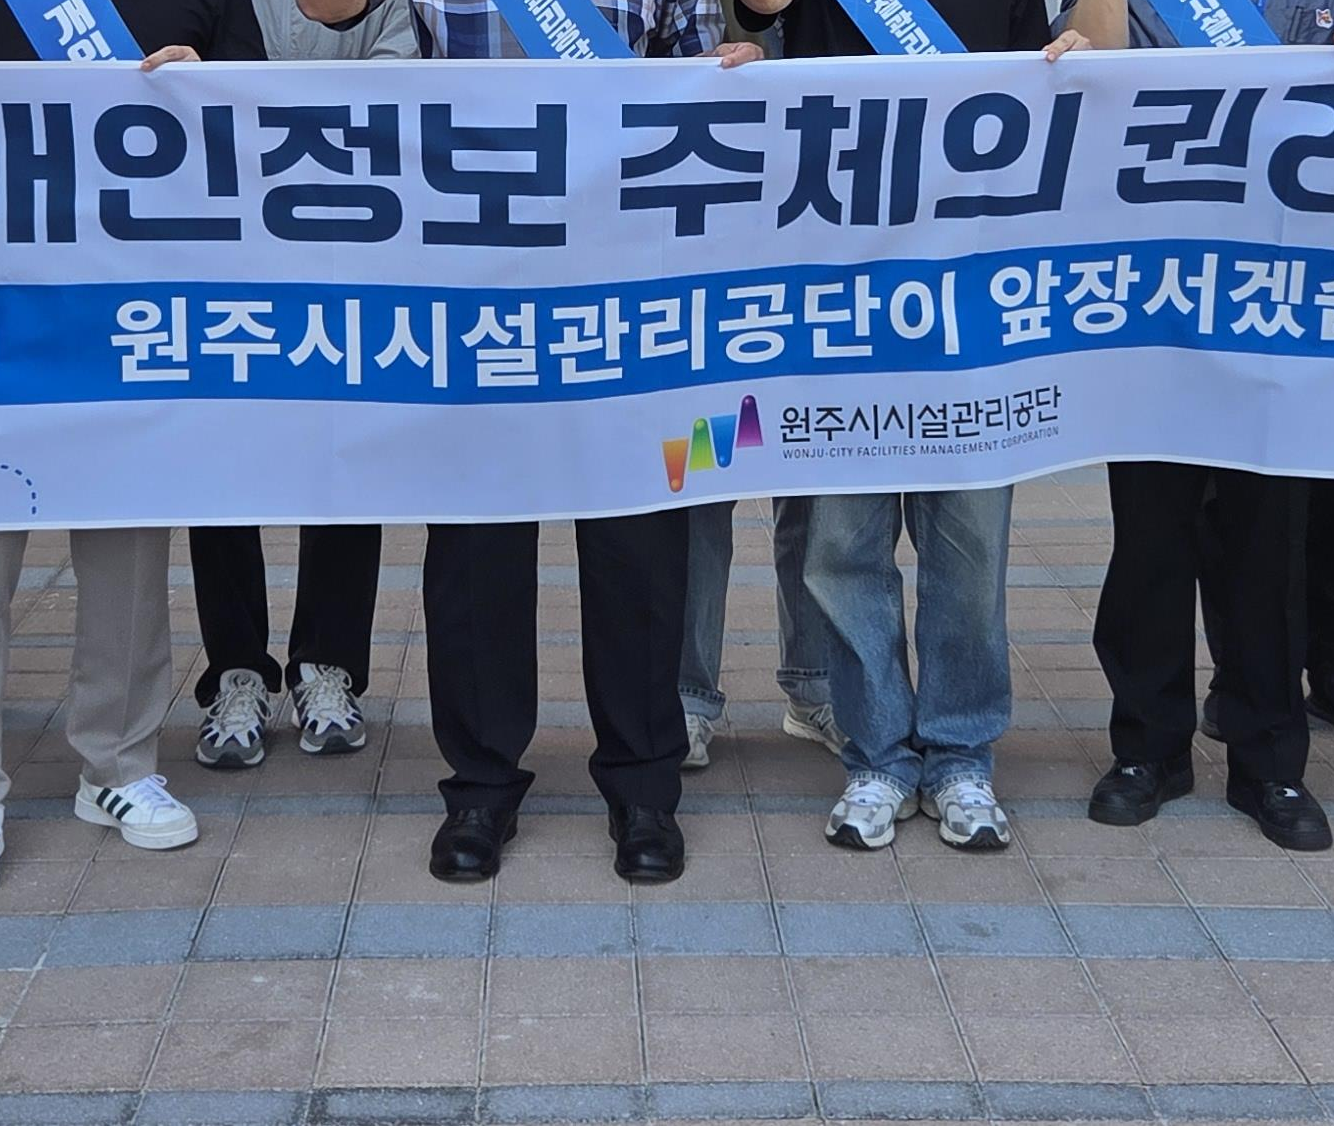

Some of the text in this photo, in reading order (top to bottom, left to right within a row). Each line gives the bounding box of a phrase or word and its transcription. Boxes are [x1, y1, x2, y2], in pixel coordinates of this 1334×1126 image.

[620, 91, 1084, 238] 주체의
[110, 271, 960, 388] 원주시시설관리공단이
[780, 385, 1062, 443] 원주시시설관리공단
[857, 445, 916, 457] FACILITIES
[920, 440, 998, 455] MANAGEMENT
[1001, 425, 1060, 449] CORPORATION
